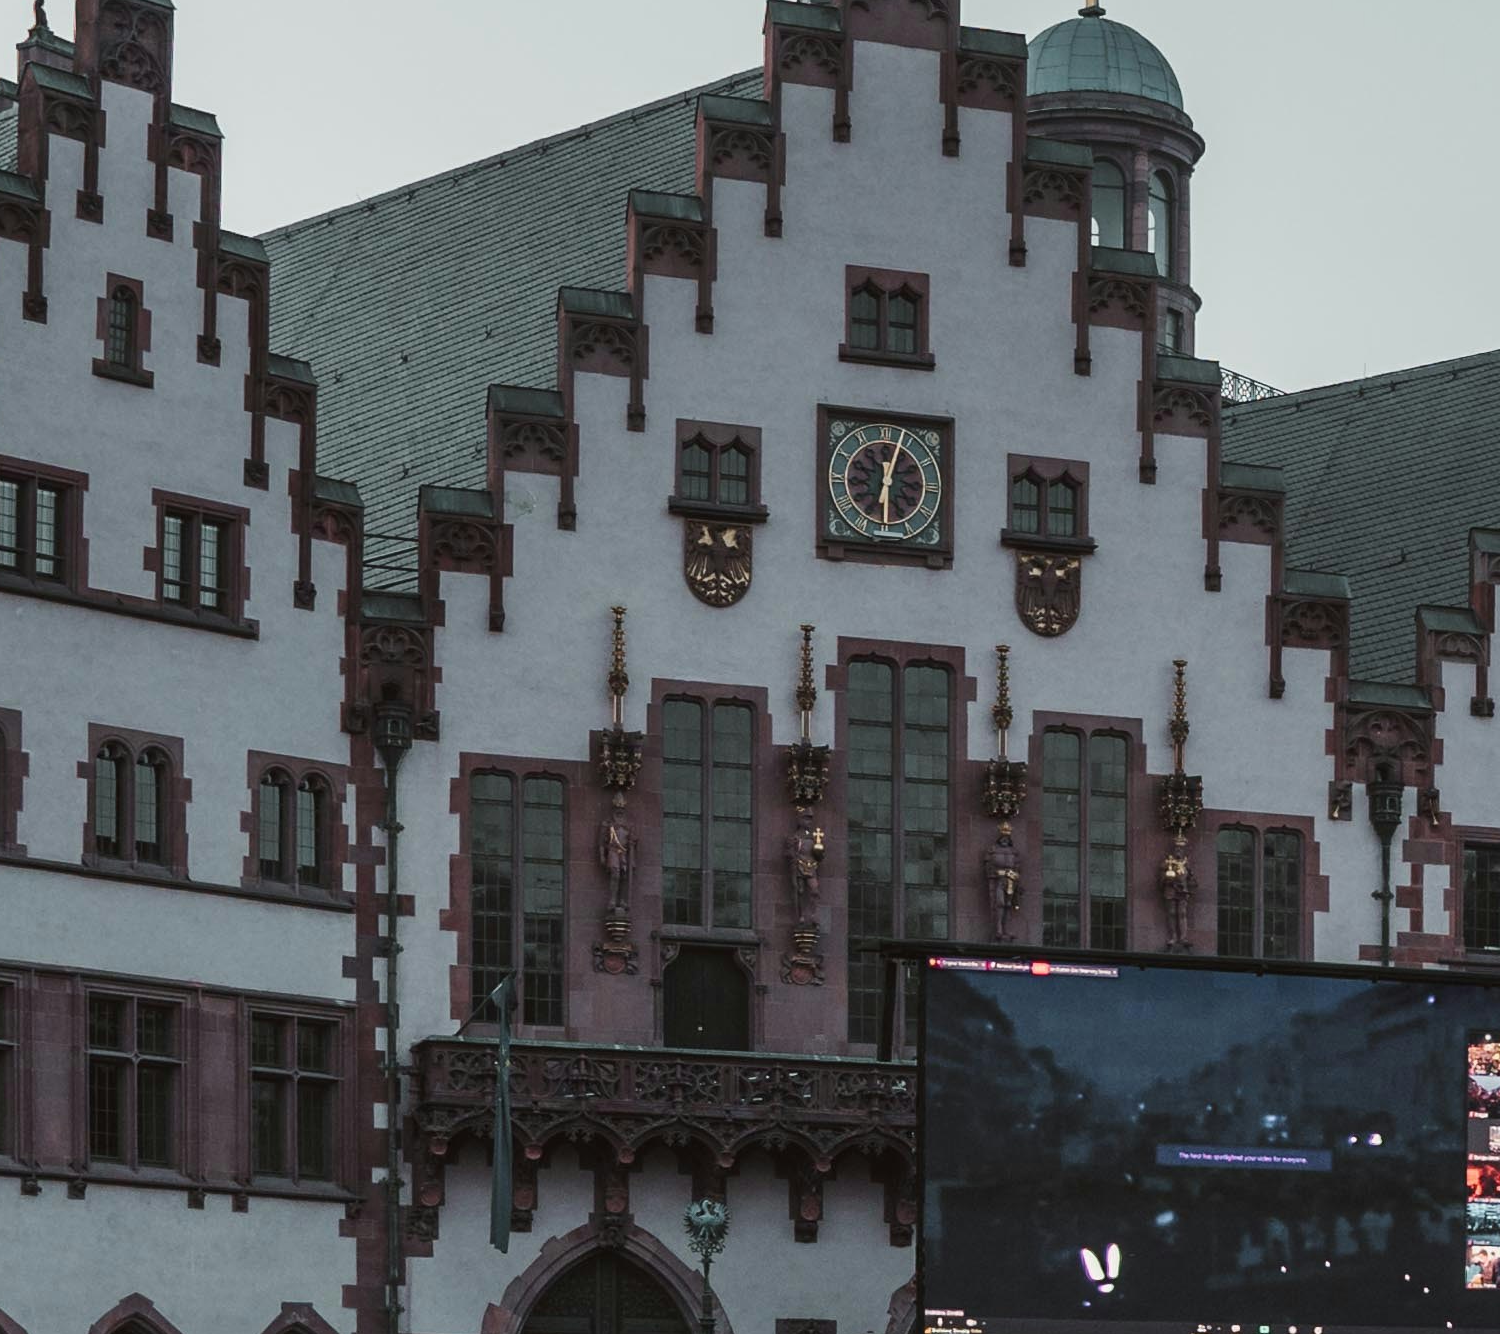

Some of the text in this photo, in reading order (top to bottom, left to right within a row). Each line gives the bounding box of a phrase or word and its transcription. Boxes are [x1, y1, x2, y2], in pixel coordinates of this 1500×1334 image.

[879, 426, 893, 442] XII
[920, 457, 932, 467] II
[924, 482, 939, 493] III
